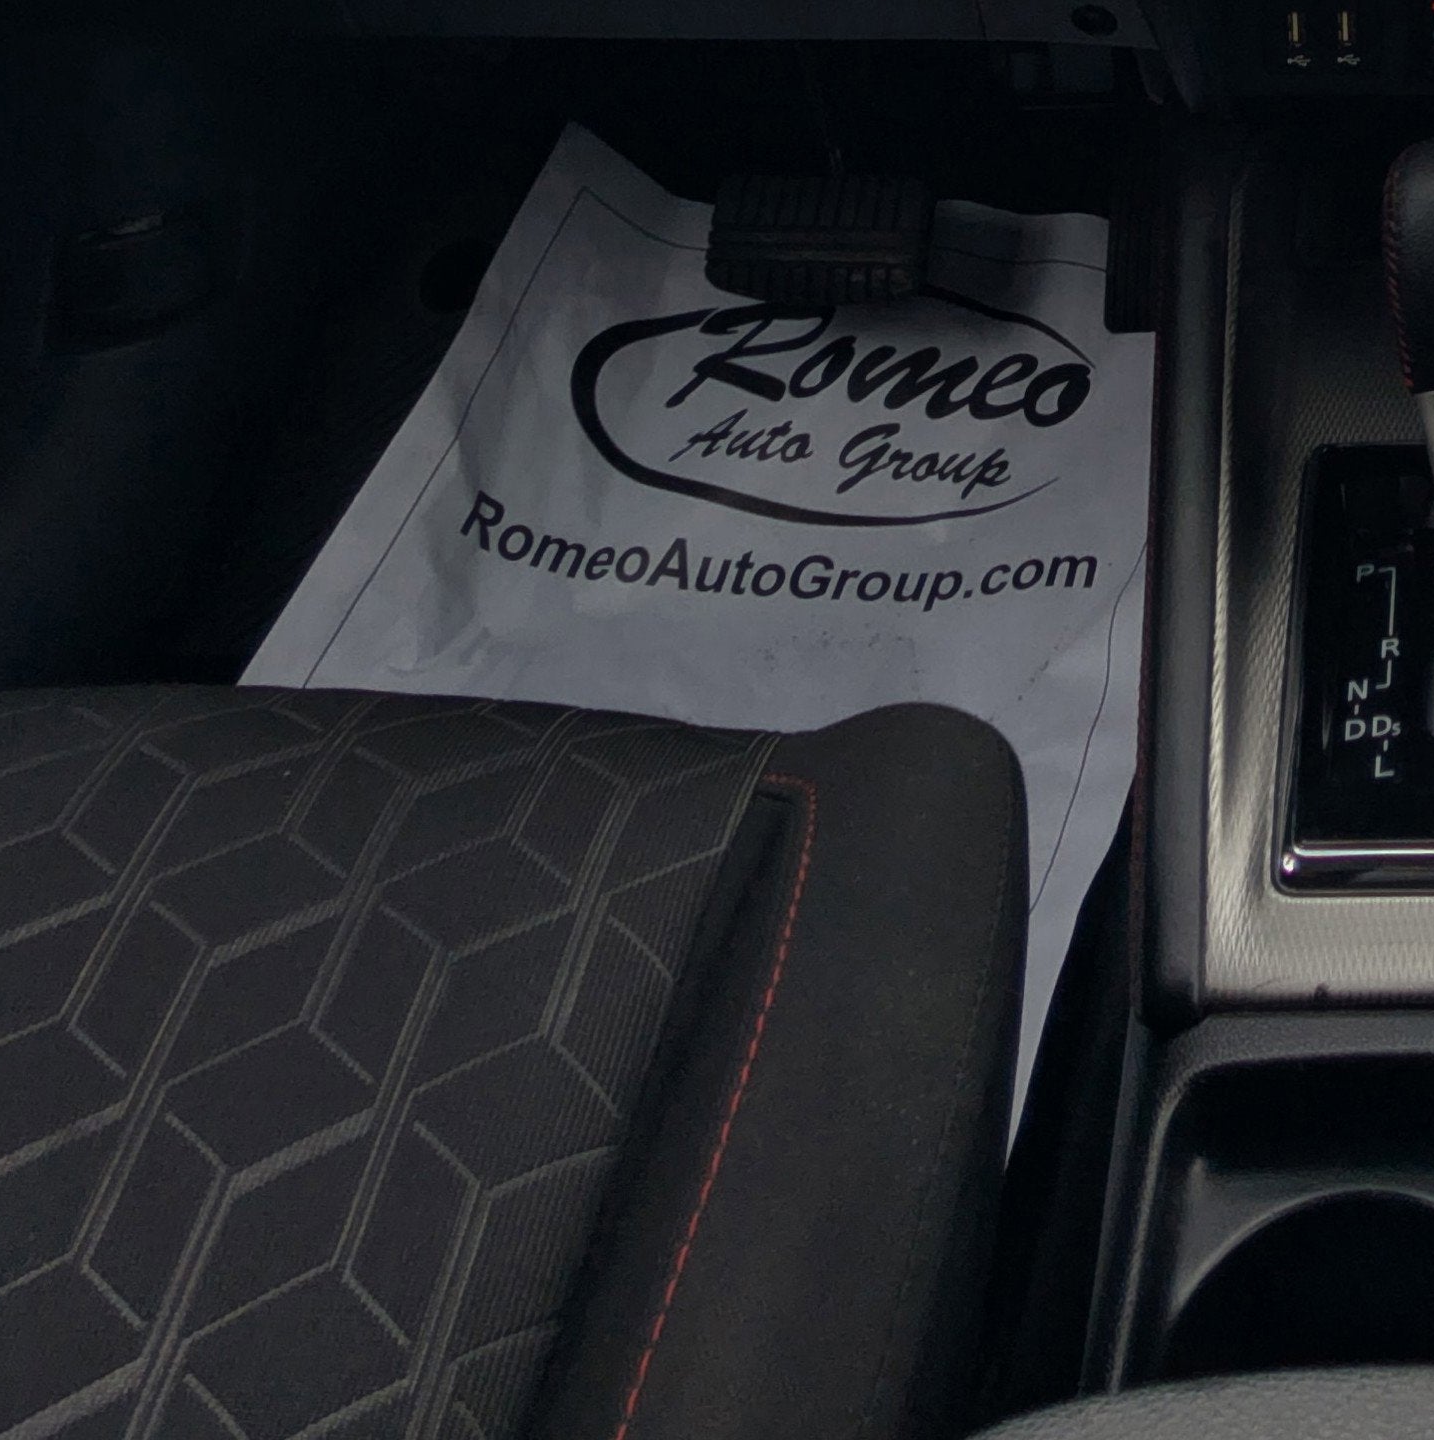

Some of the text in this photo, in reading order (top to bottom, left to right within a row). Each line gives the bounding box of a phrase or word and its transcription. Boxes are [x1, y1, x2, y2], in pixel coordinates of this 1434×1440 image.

[663, 302, 1094, 432] Romeo
[668, 407, 1013, 499] Auto Group
[459, 489, 1099, 612] RomeoAutoGroup.com
[1356, 564, 1375, 583] P
[1381, 638, 1401, 658] R
[1346, 679, 1369, 702] N
[1344, 719, 1367, 742] D
[1373, 756, 1395, 779] L
